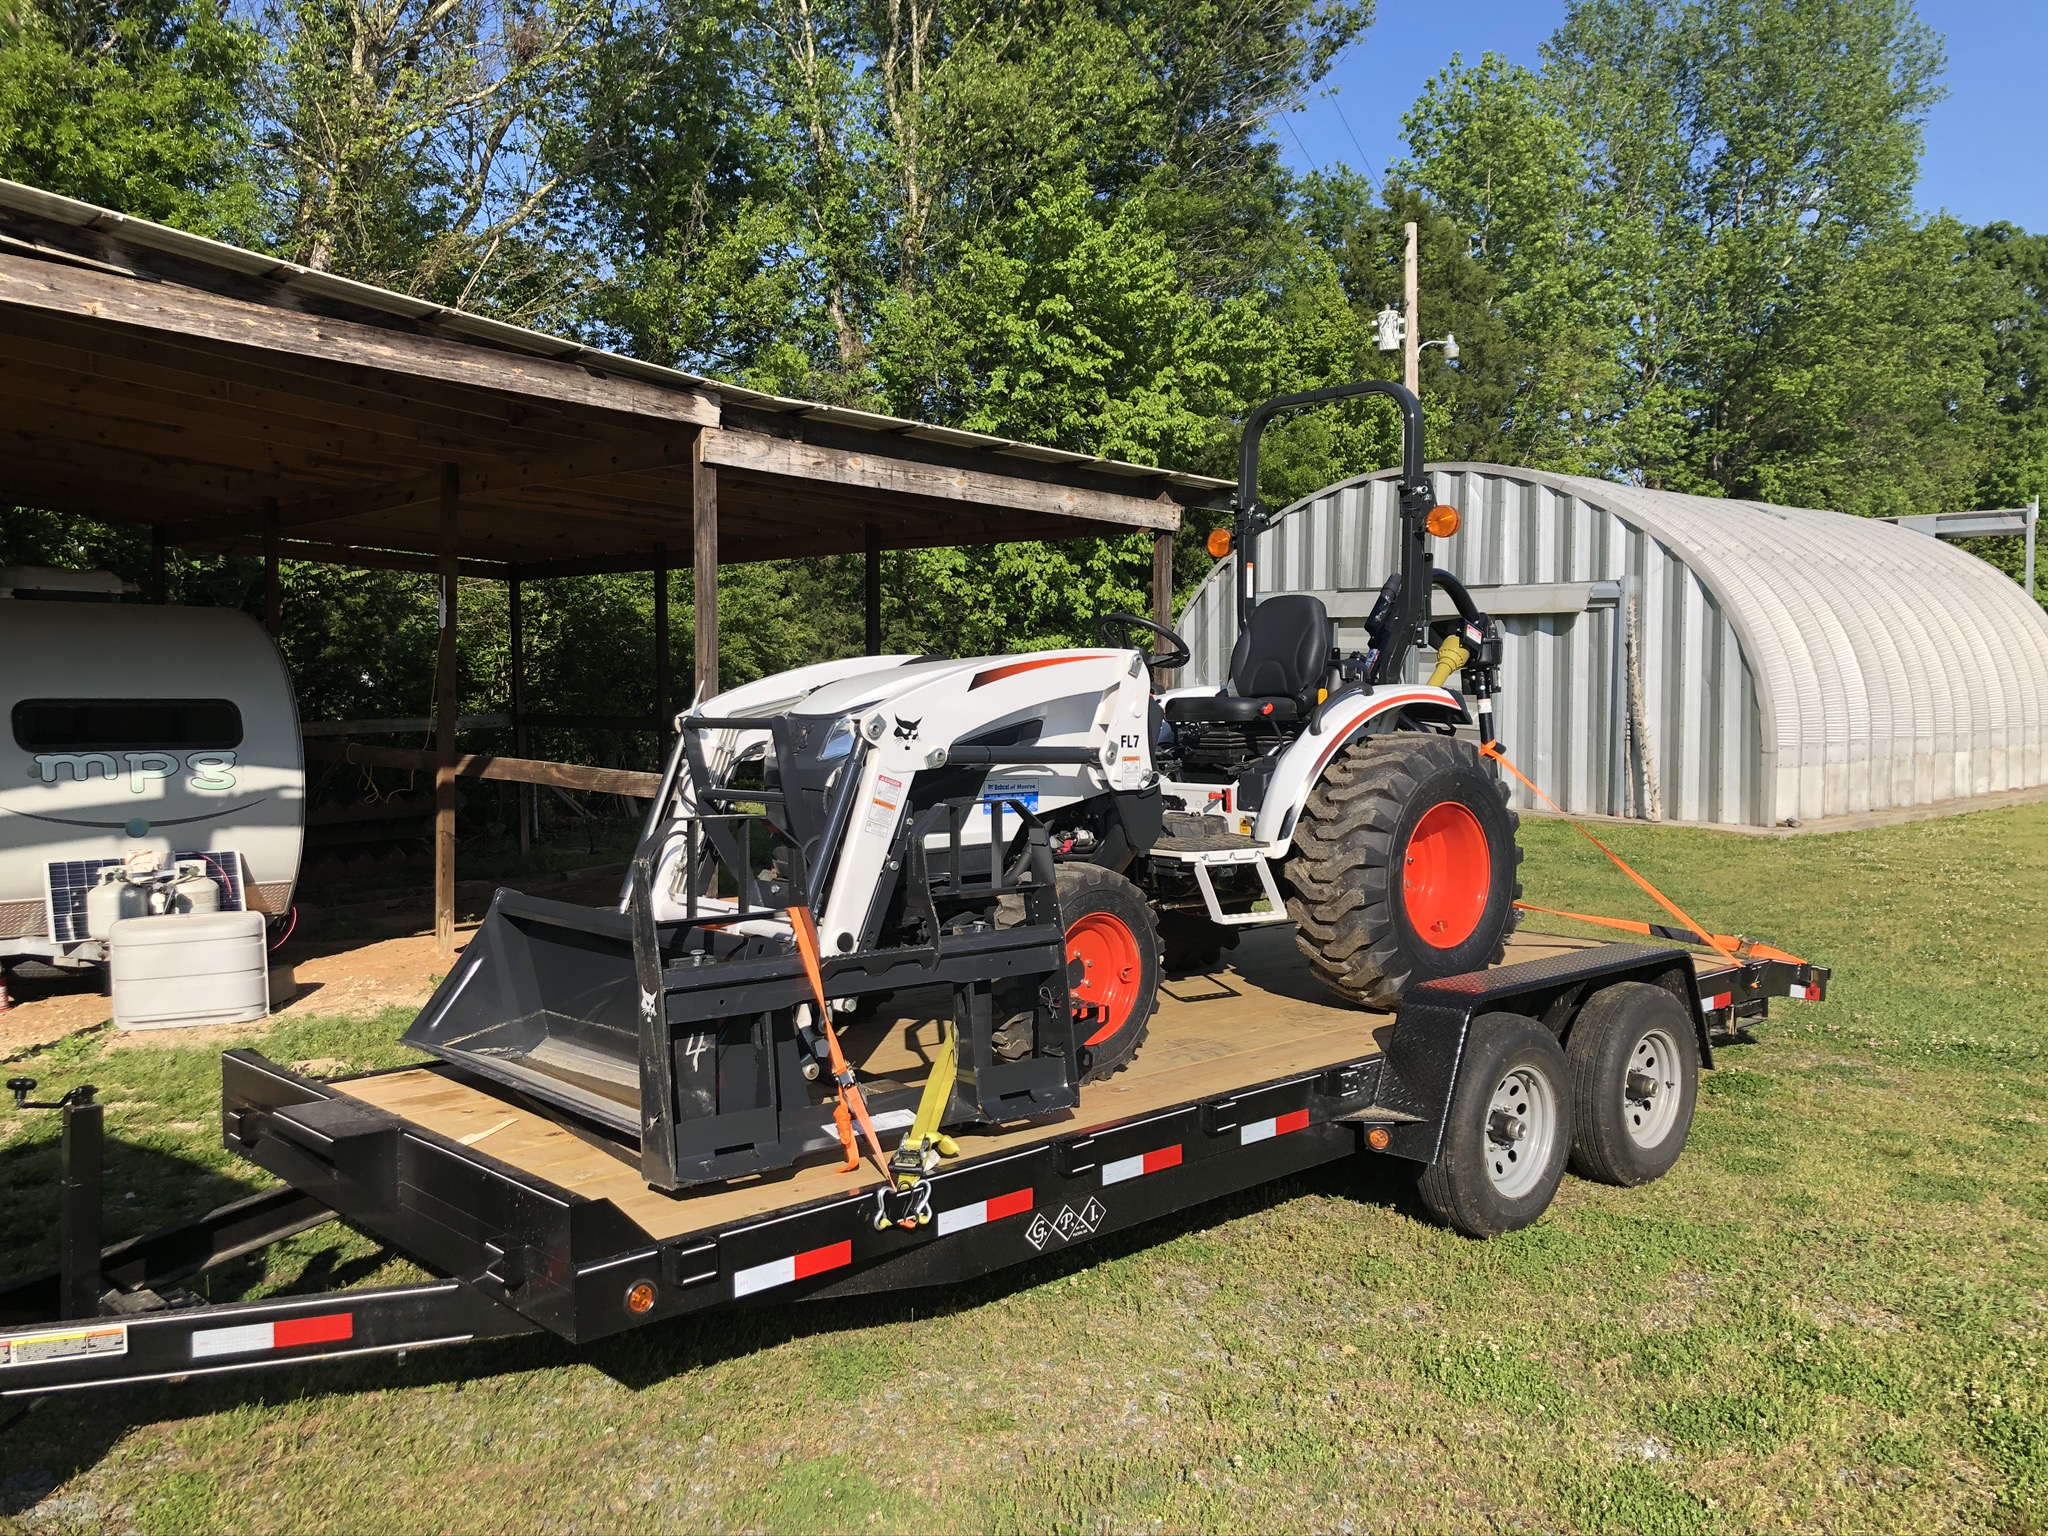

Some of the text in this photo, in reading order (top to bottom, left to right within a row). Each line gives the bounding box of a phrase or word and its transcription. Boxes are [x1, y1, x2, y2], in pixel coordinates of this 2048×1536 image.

[1121, 734, 1140, 748] FL7
[34, 751, 237, 794] mpg
[994, 783, 1010, 791] Bobcat
[685, 1031, 708, 1073] 4
